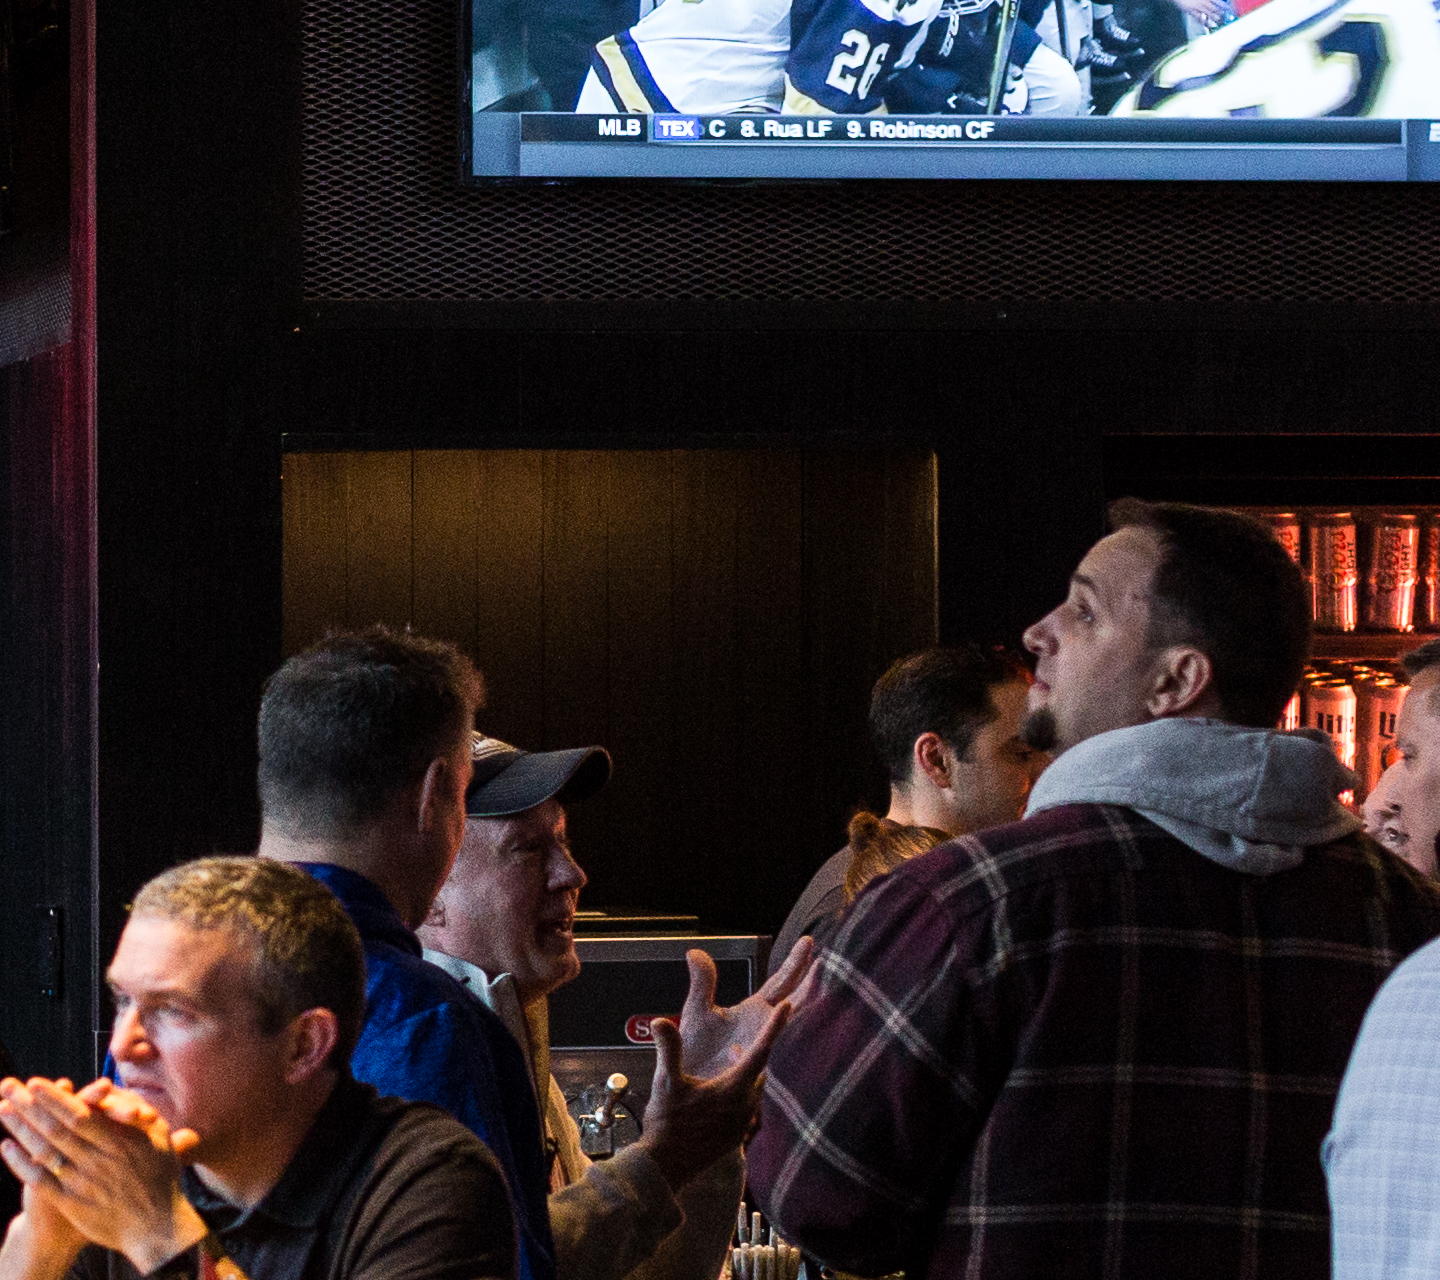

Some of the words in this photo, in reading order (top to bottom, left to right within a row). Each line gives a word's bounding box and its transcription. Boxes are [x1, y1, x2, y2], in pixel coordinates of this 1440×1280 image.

[597, 121, 642, 137] MLB
[660, 122, 696, 138] TEX
[709, 122, 726, 138] C
[740, 122, 760, 138] 8.
[763, 121, 803, 138] Rua
[807, 122, 832, 138] LF
[847, 122, 866, 138] 9.
[869, 121, 962, 139] Robinson
[965, 122, 995, 139] CF
